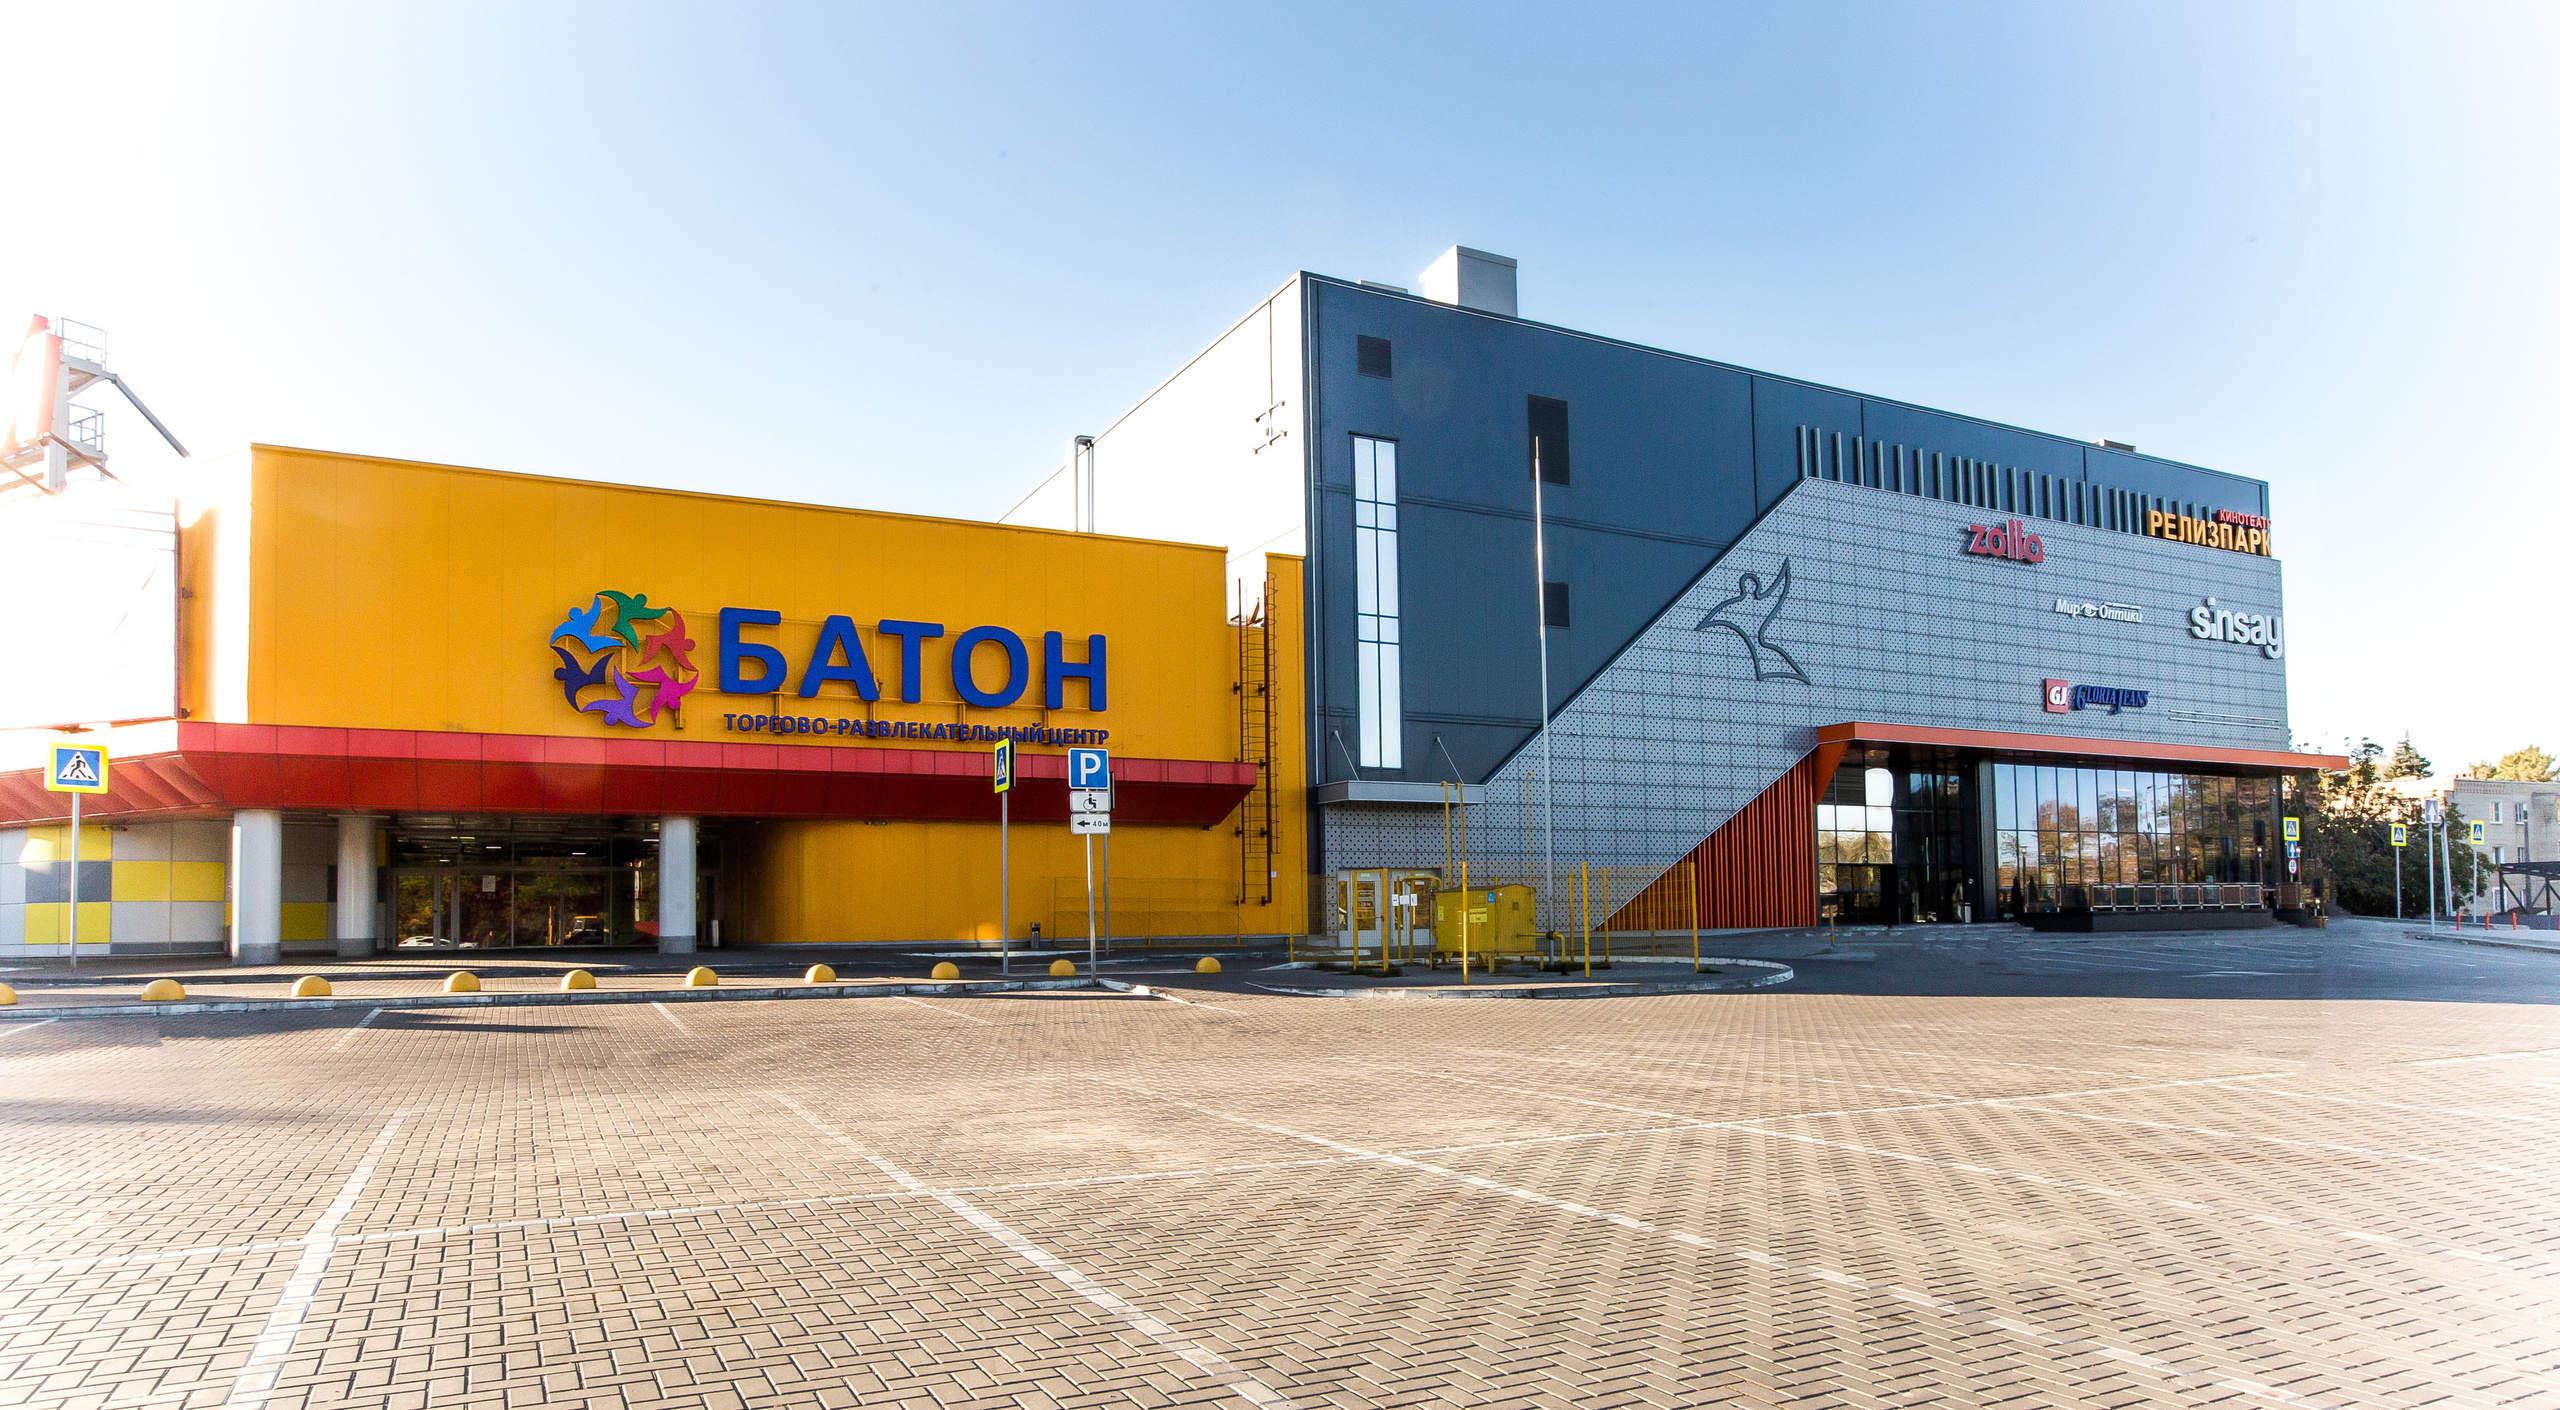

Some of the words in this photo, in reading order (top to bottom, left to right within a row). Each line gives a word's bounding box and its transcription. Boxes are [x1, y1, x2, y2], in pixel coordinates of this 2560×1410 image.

[2148, 510, 2272, 557] РЕЛИЗПАРК
[2218, 509, 2271, 530] КИНОТЕАТР
[1968, 519, 2044, 563] zolla
[2055, 599, 2080, 617] Мир
[2099, 604, 2143, 623] Оптики
[2191, 597, 2283, 659] sinsay
[719, 607, 1107, 712] БАТОН
[2049, 686, 2068, 705] GJ
[2075, 685, 2117, 710] GLORIA
[2109, 688, 2150, 715] JEANS
[723, 713, 1044, 743] ТОРГОВО-РАЗВЛЕКАТЕЛЬНЫЙ
[1050, 727, 1110, 747] ЦЕНТР
[1080, 752, 1101, 785] P
